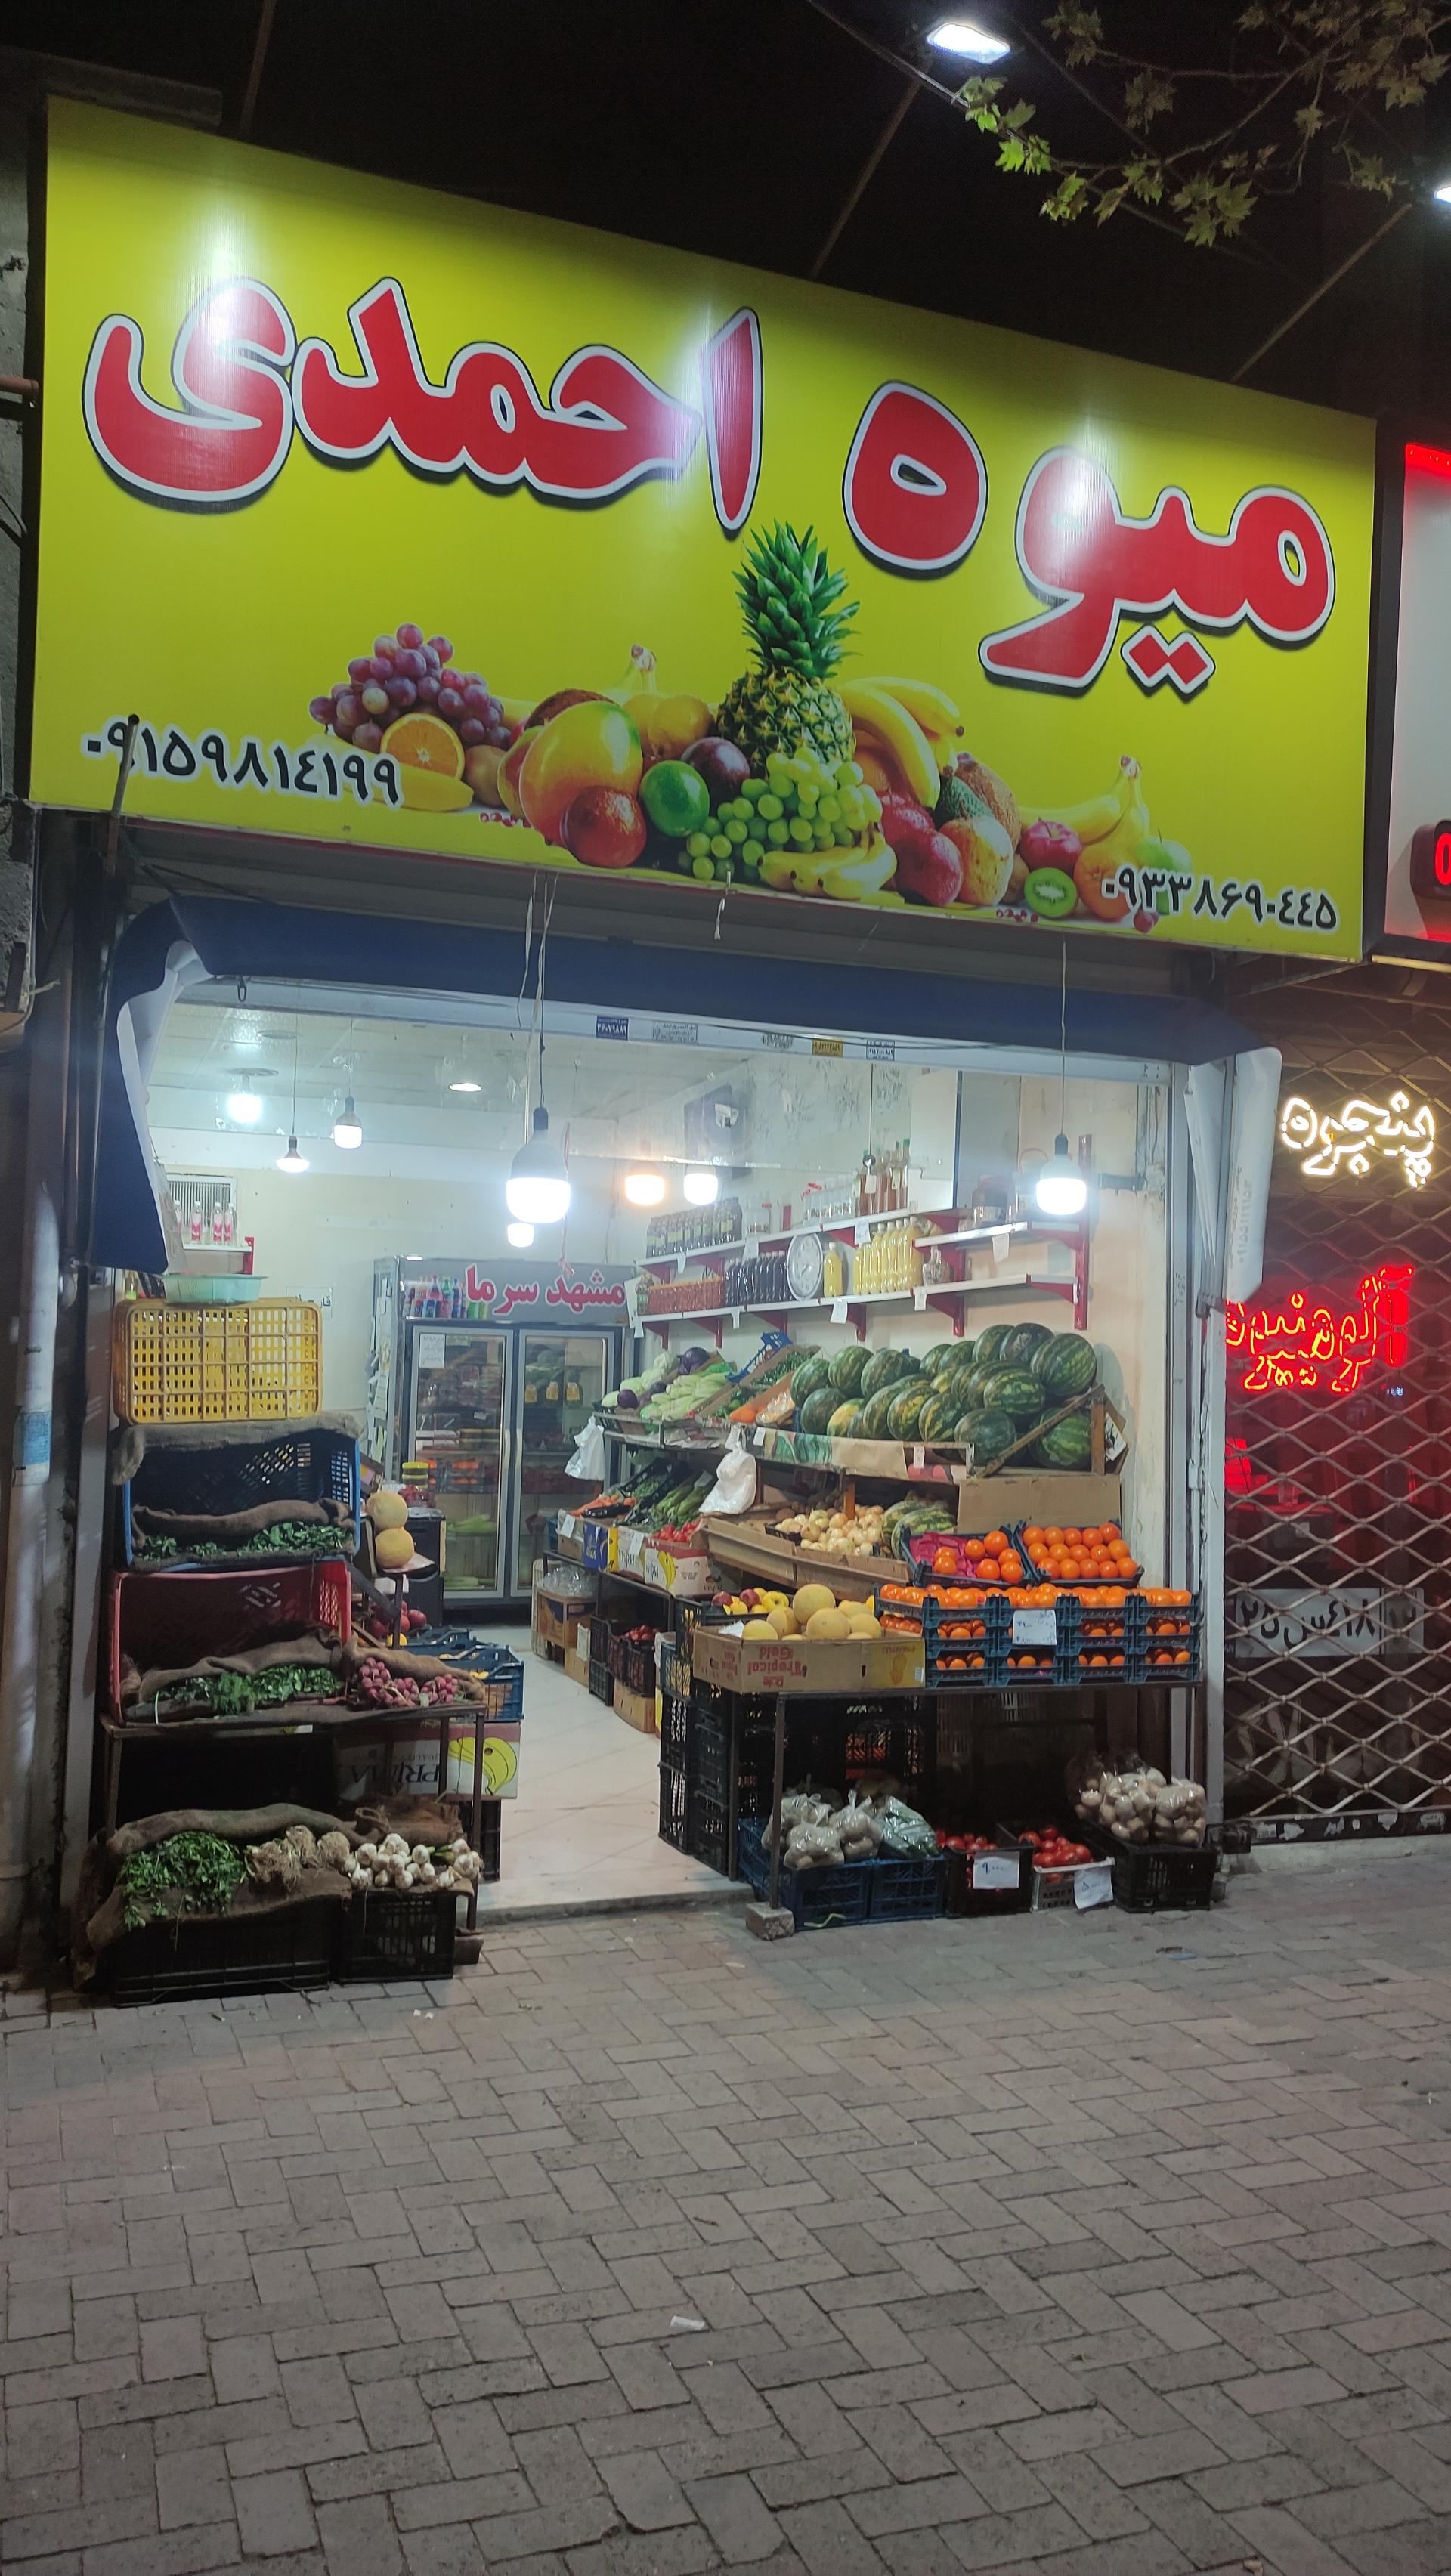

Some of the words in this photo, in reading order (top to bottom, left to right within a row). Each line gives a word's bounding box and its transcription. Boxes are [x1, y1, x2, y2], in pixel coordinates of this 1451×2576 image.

[82, 276, 763, 532] احمدی
[843, 379, 1335, 691] میوه
[1105, 867, 1337, 930] ۰۹۳۳۸۶۹۰۴۴۵
[1280, 1090, 1436, 1189] پنجره
[545, 1269, 628, 1315] مشهد
[747, 1660, 803, 1676] Tropical
[760, 1646, 793, 1660] Gold
